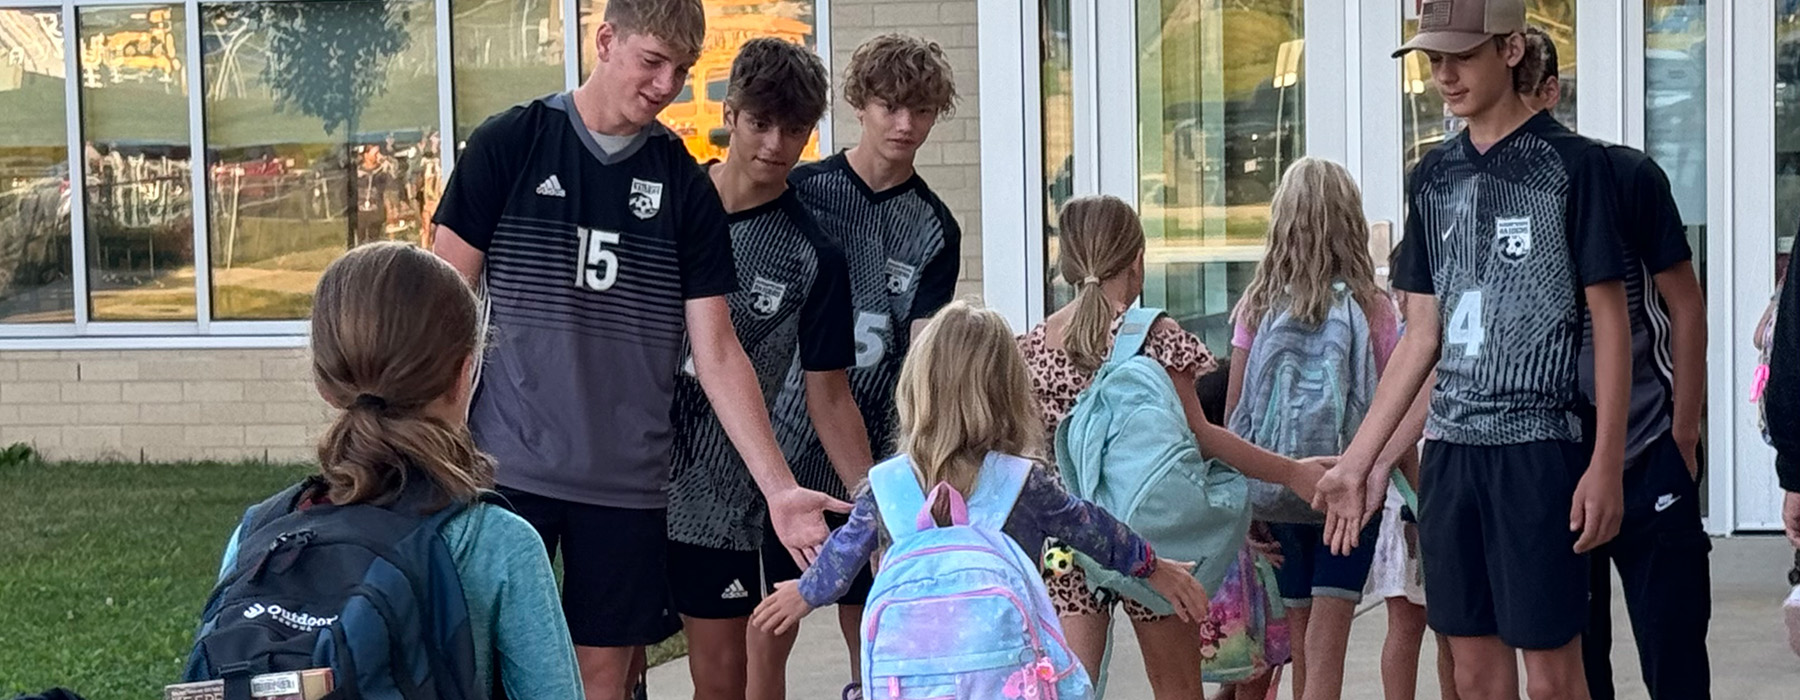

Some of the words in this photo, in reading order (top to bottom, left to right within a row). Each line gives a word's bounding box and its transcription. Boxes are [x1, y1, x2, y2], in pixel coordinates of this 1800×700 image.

[574, 226, 620, 291] 15
[1448, 290, 1485, 356] 4
[267, 605, 339, 627] Outdoor
